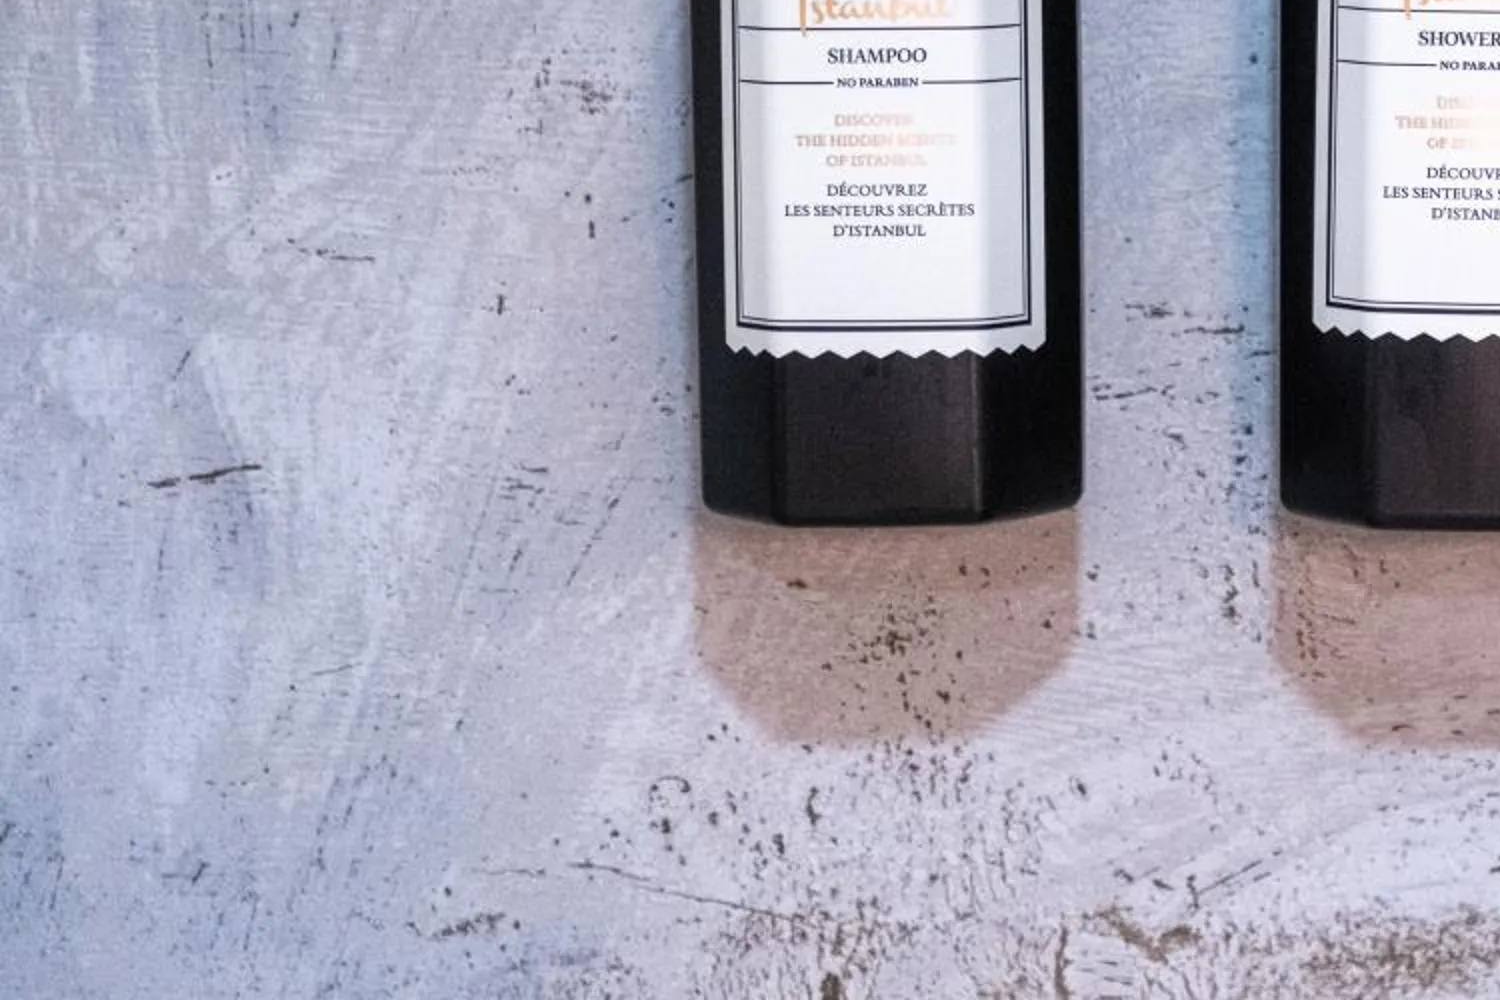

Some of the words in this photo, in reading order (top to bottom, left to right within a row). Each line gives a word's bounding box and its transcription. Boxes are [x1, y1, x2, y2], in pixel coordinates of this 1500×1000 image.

[827, 47, 927, 65] SHAMPOO
[1440, 60, 1460, 71] NO
[837, 77, 857, 89] NO
[859, 77, 919, 89] PARABEN
[793, 133, 827, 148] THE
[825, 153, 848, 167] OF
[827, 180, 928, 197] DÉCOUVREZ
[1383, 186, 1409, 200] LES
[1412, 186, 1494, 201] SENTEURS
[785, 204, 811, 218] LES
[813, 203, 895, 218] SENTEURS
[897, 201, 975, 217] SECRÈTES
